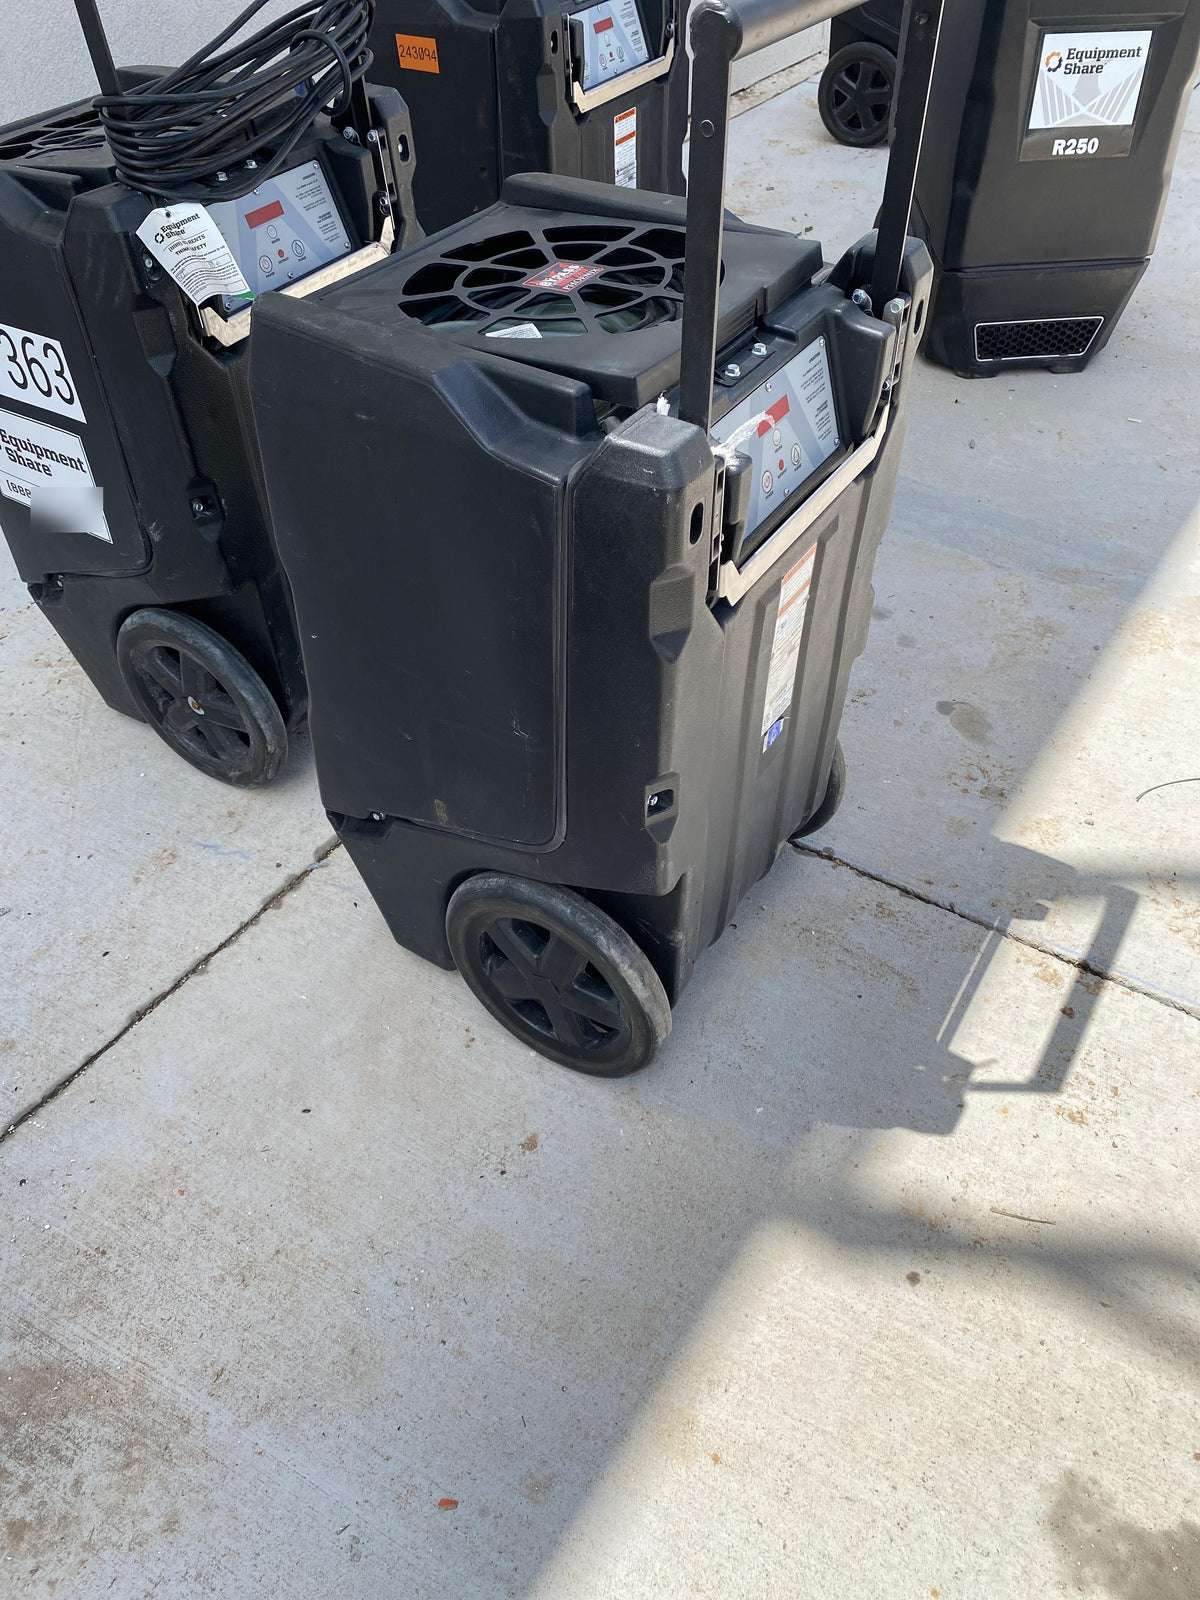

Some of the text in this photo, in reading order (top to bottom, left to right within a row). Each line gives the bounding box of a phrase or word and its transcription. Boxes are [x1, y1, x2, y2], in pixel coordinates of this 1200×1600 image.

[399, 44, 437, 62] 243094
[1066, 46, 1143, 62] Equipment
[1063, 63, 1104, 75] Share
[1051, 138, 1099, 156] R250
[160, 213, 201, 233] Equipment
[165, 229, 186, 239] Share
[0, 328, 75, 405] 363
[0, 429, 87, 473] Equipment
[7, 447, 52, 477] Share
